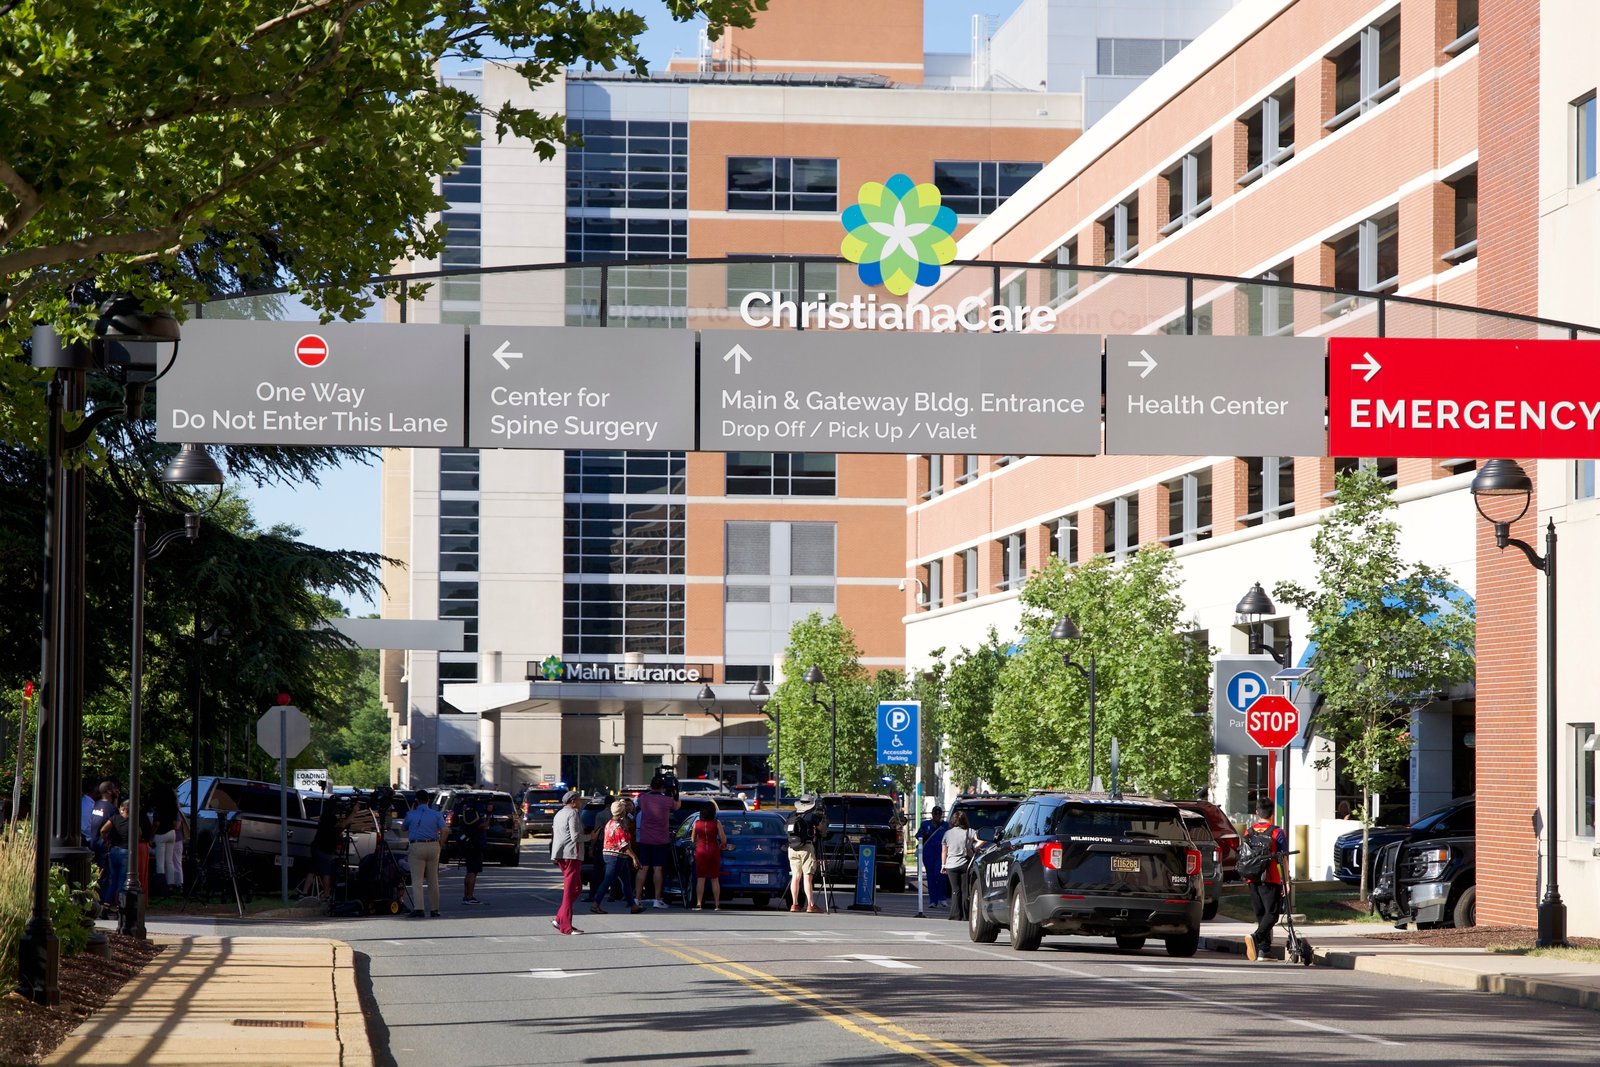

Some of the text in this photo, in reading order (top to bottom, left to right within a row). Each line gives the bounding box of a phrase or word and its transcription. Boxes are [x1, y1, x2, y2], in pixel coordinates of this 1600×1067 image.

[739, 291, 1057, 333] ChristianaCare
[256, 382, 365, 409] One Way
[490, 387, 610, 408] Center for
[722, 390, 1085, 417] Main & Gateway Bldg. Entrance
[1128, 395, 1289, 416] Health Center
[172, 408, 448, 433] Do Not Enter This Lane
[1350, 398, 1600, 431] EMERGENCY
[490, 415, 659, 442] Spine Surgery
[722, 421, 977, 442] Drop Off / Pick Up / Valet
[566, 663, 700, 682] Main Entrance
[1238, 678, 1260, 708] P
[892, 711, 906, 728] P
[1249, 711, 1296, 732] STOP
[991, 861, 1009, 879] POLICE
